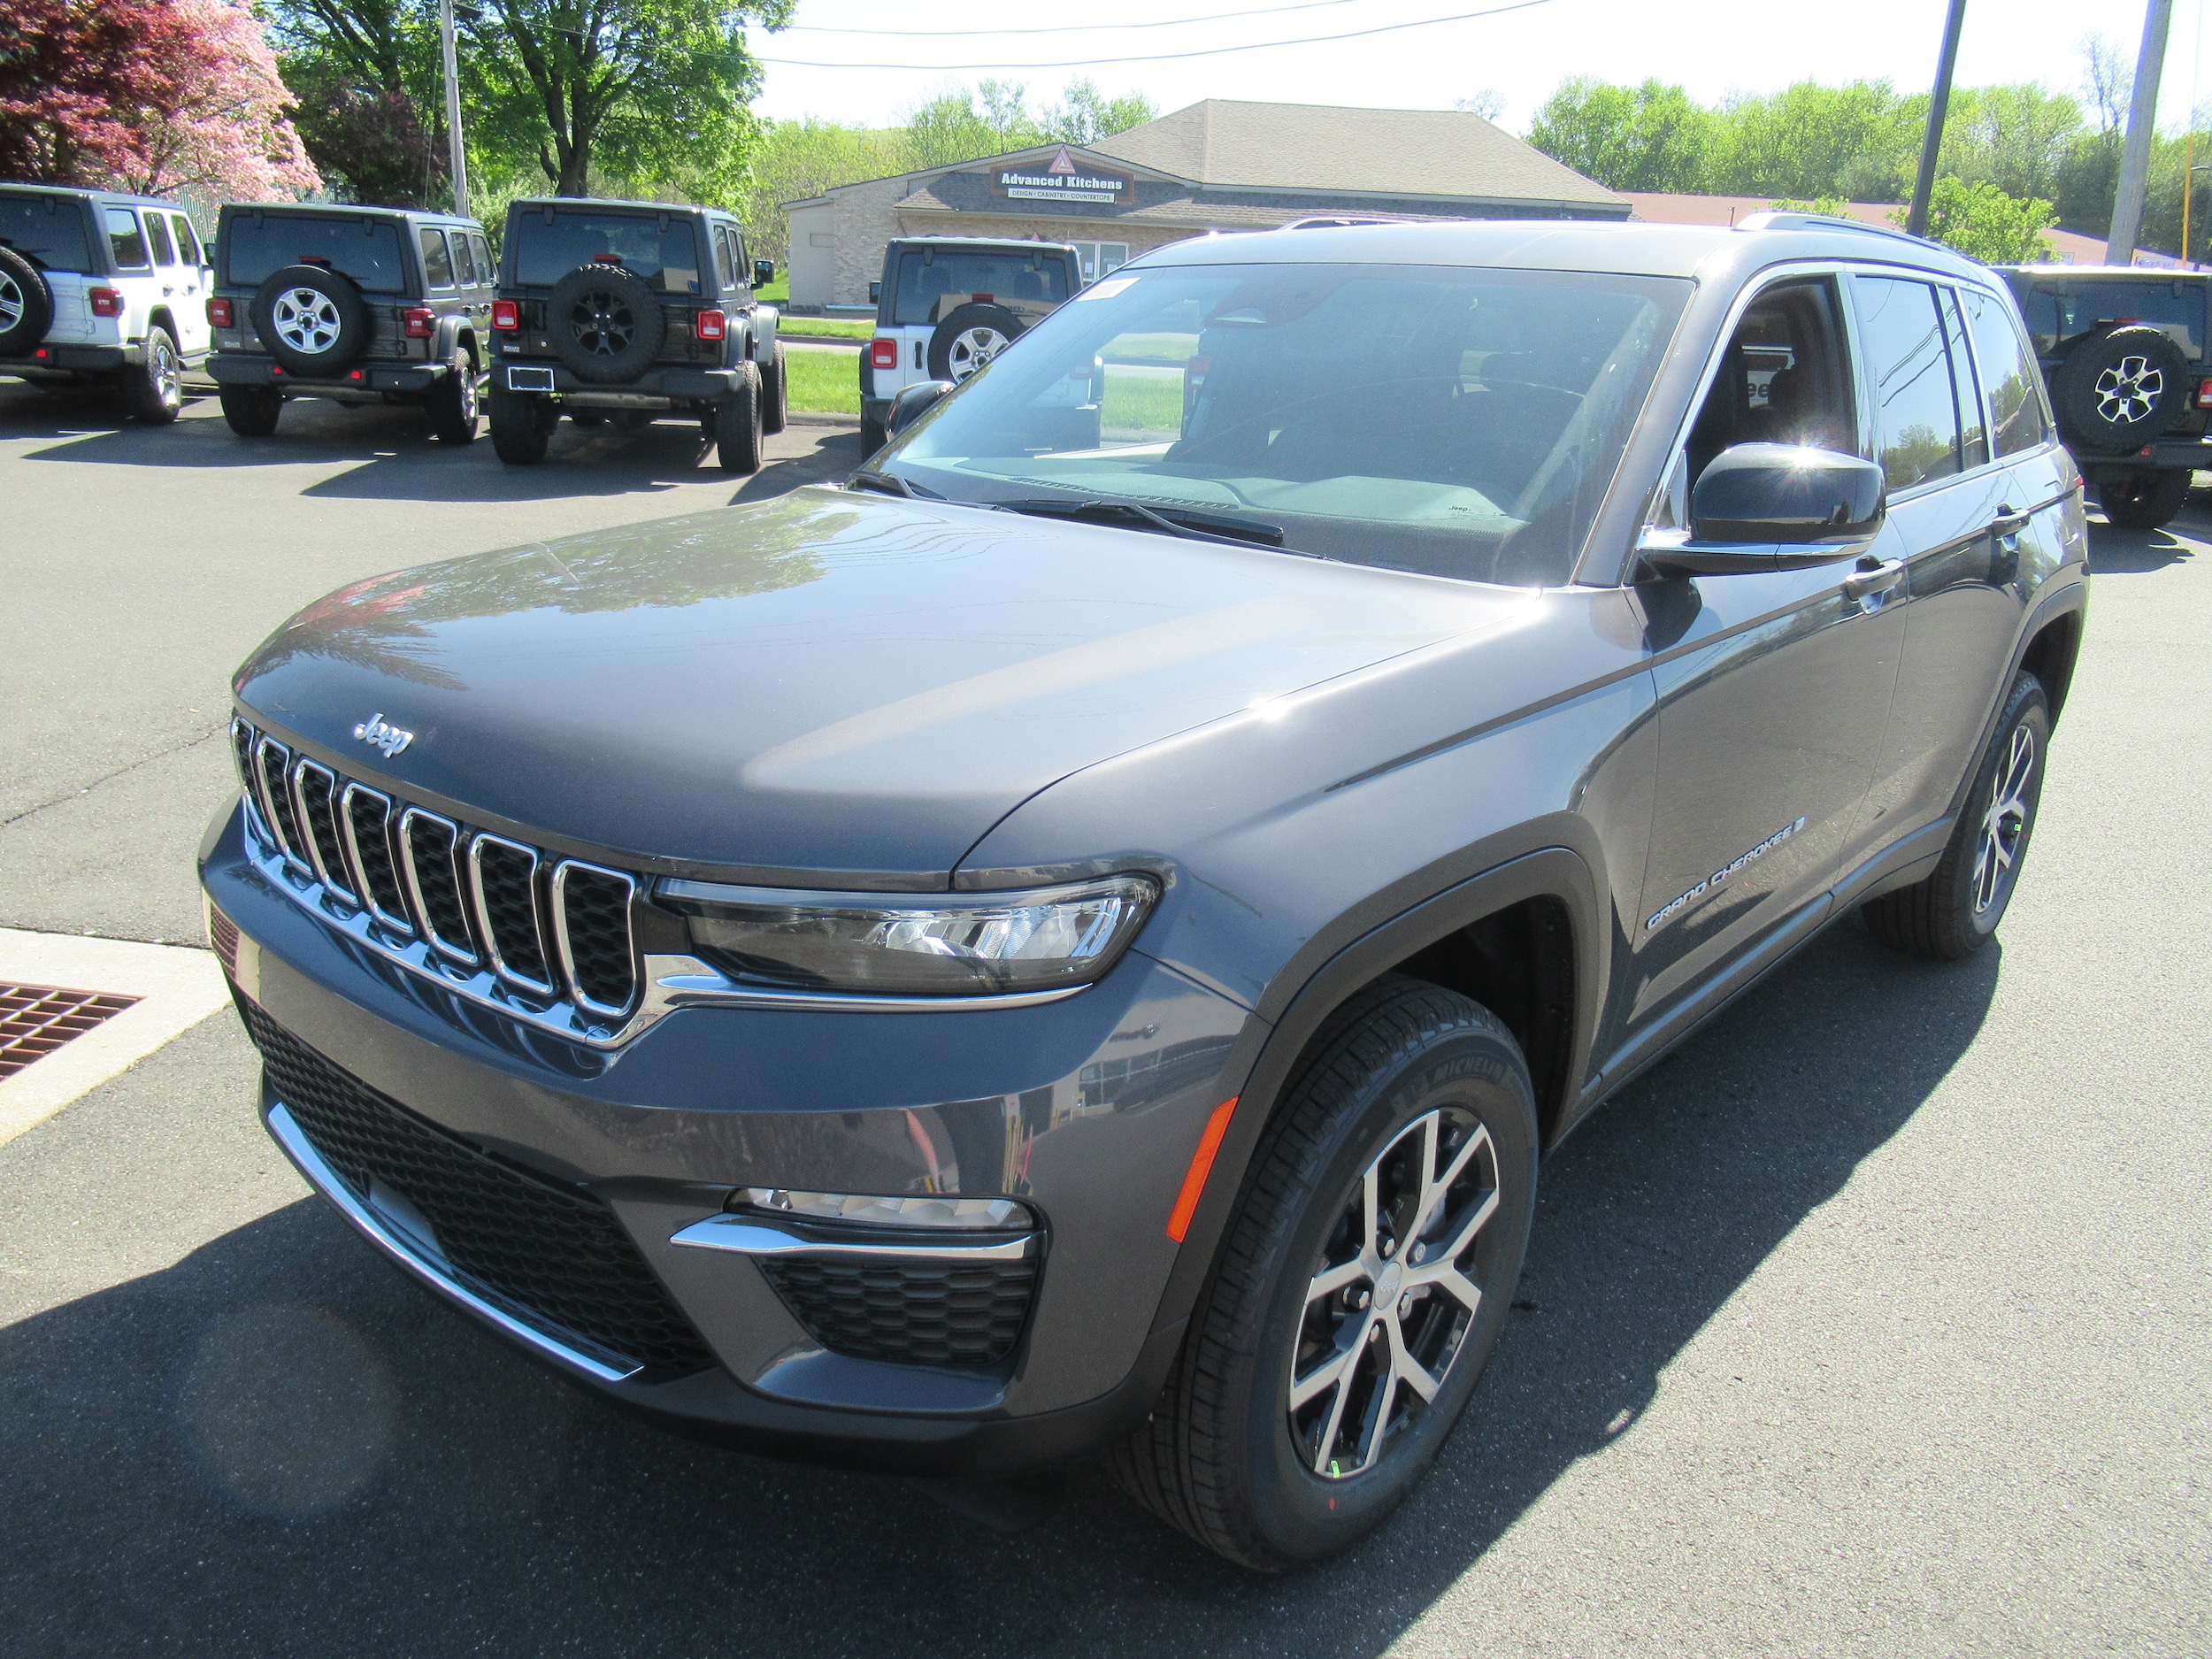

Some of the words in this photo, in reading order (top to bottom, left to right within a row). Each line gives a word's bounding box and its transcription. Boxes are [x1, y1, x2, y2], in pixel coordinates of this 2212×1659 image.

[1001, 173, 1063, 187] Advanced
[1066, 176, 1123, 190] Kitchens
[354, 712, 414, 758] Jeep
[1644, 881, 1706, 930] GRAND
[1708, 825, 1793, 886] CHEROKEE
[1434, 1056, 1507, 1084] MICHELIN
